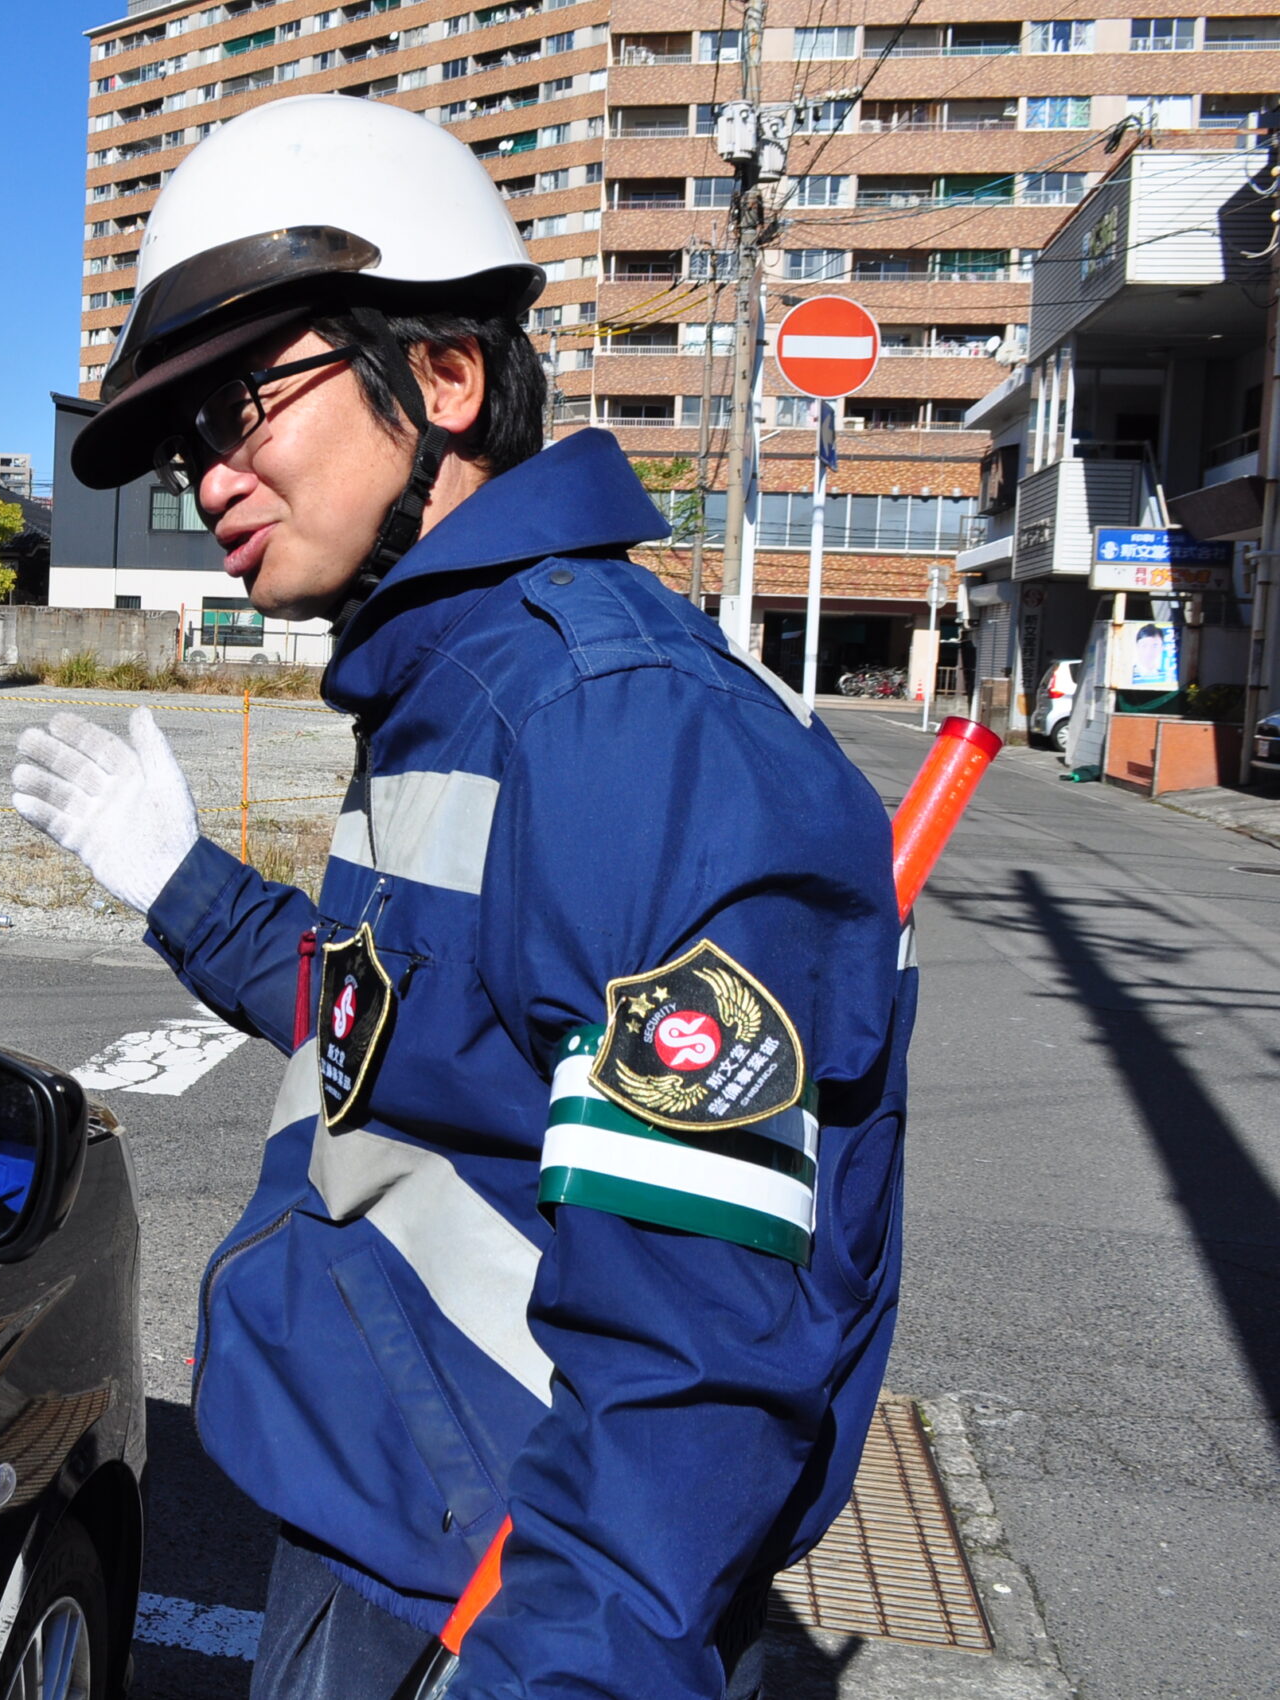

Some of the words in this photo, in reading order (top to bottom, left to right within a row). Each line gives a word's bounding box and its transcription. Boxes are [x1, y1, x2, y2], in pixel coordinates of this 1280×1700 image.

[643, 1003, 678, 1044] SECURITY
[705, 1043, 751, 1090] 斯文堂
[707, 1037, 780, 1116] 警備事業部
